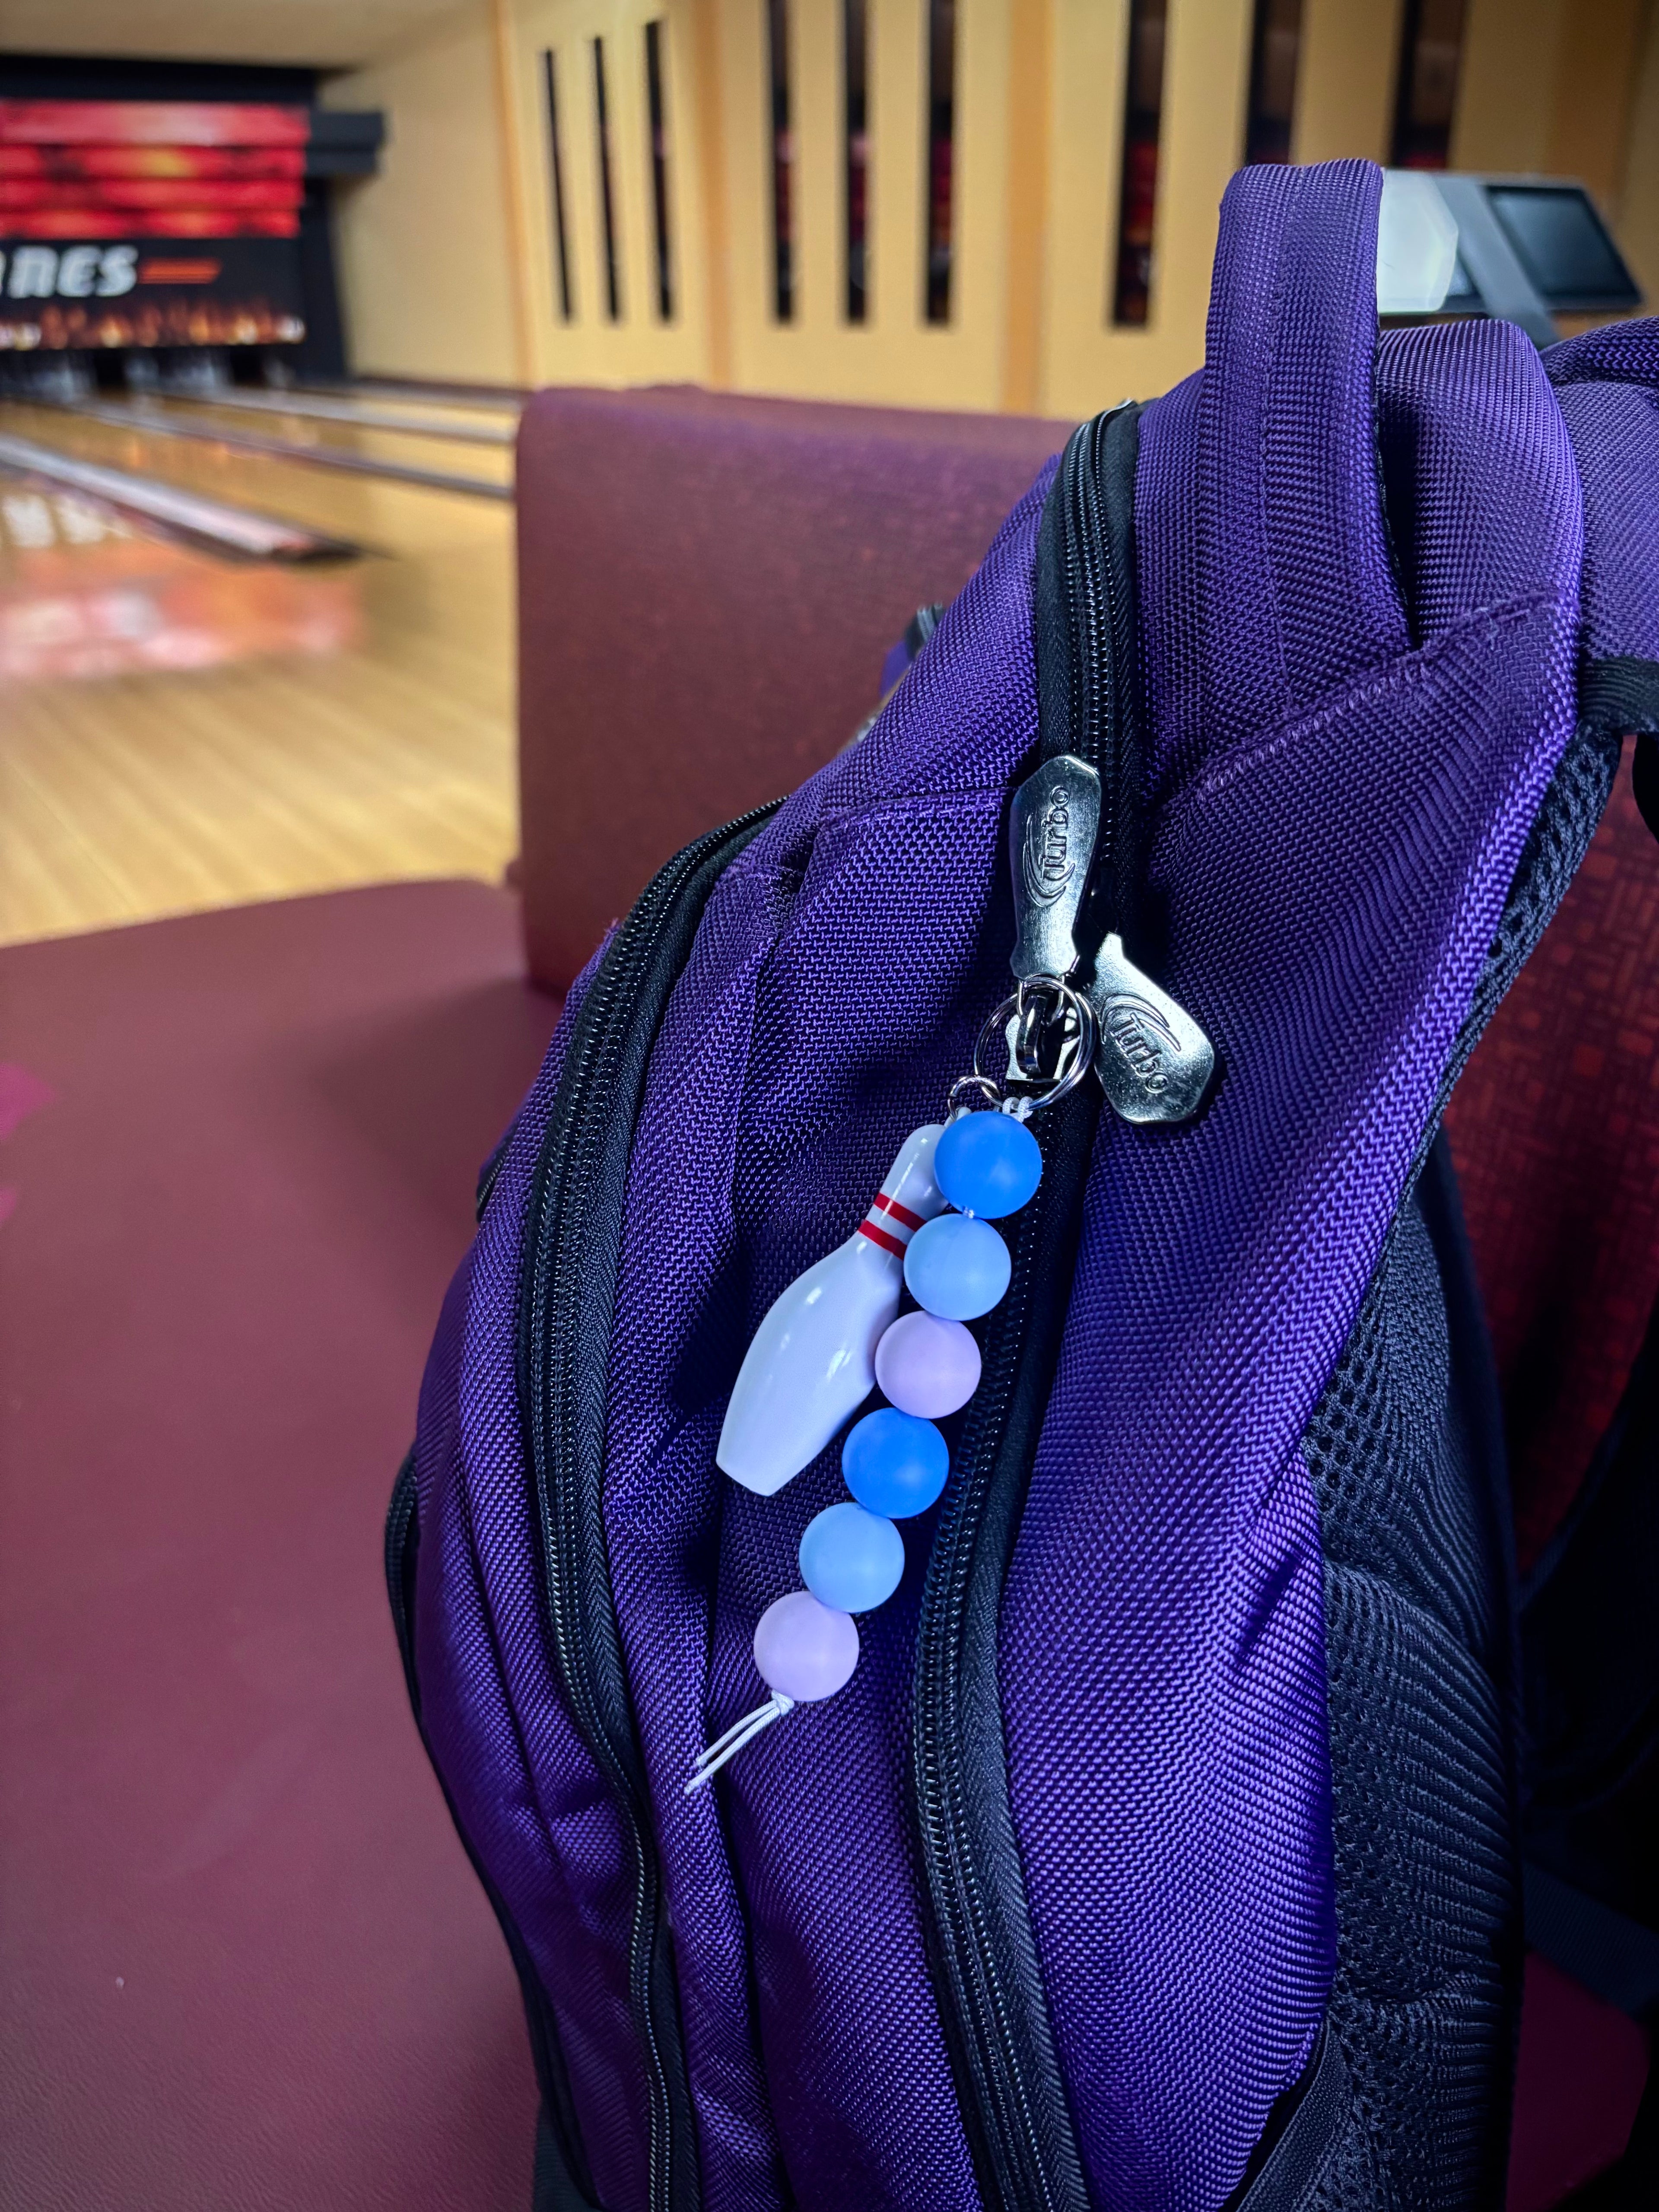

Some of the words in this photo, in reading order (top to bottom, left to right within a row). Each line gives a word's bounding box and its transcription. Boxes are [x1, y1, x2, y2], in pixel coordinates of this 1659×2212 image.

[0, 245, 139, 299] NES
[1038, 785, 1070, 880] Turbo
[1109, 1011, 1169, 1094] Turbo
